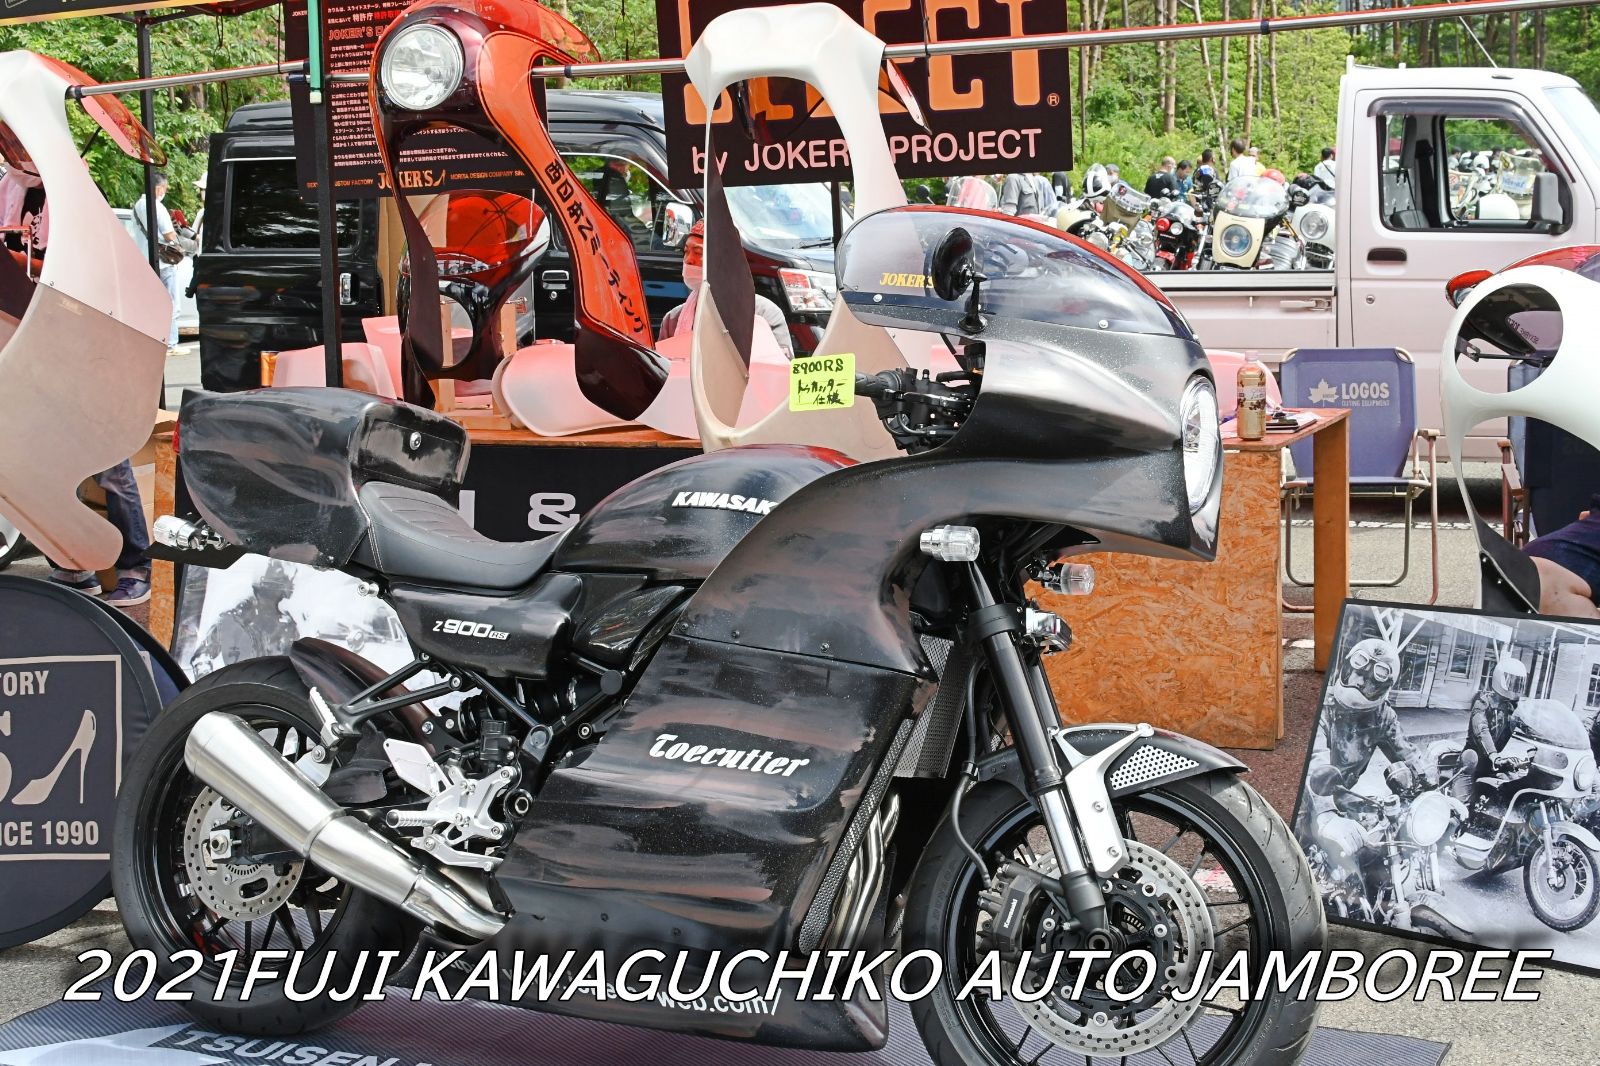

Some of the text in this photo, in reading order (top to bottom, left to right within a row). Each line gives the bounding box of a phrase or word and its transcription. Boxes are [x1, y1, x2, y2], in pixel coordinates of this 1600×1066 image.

[889, 128, 1042, 165] PROJECT
[1341, 382, 1390, 400] LOGOS
[672, 491, 778, 516] KAWASAK
[0, 670, 50, 697] ORY
[649, 733, 810, 777] Toecutter
[0, 820, 99, 847] CE 1990
